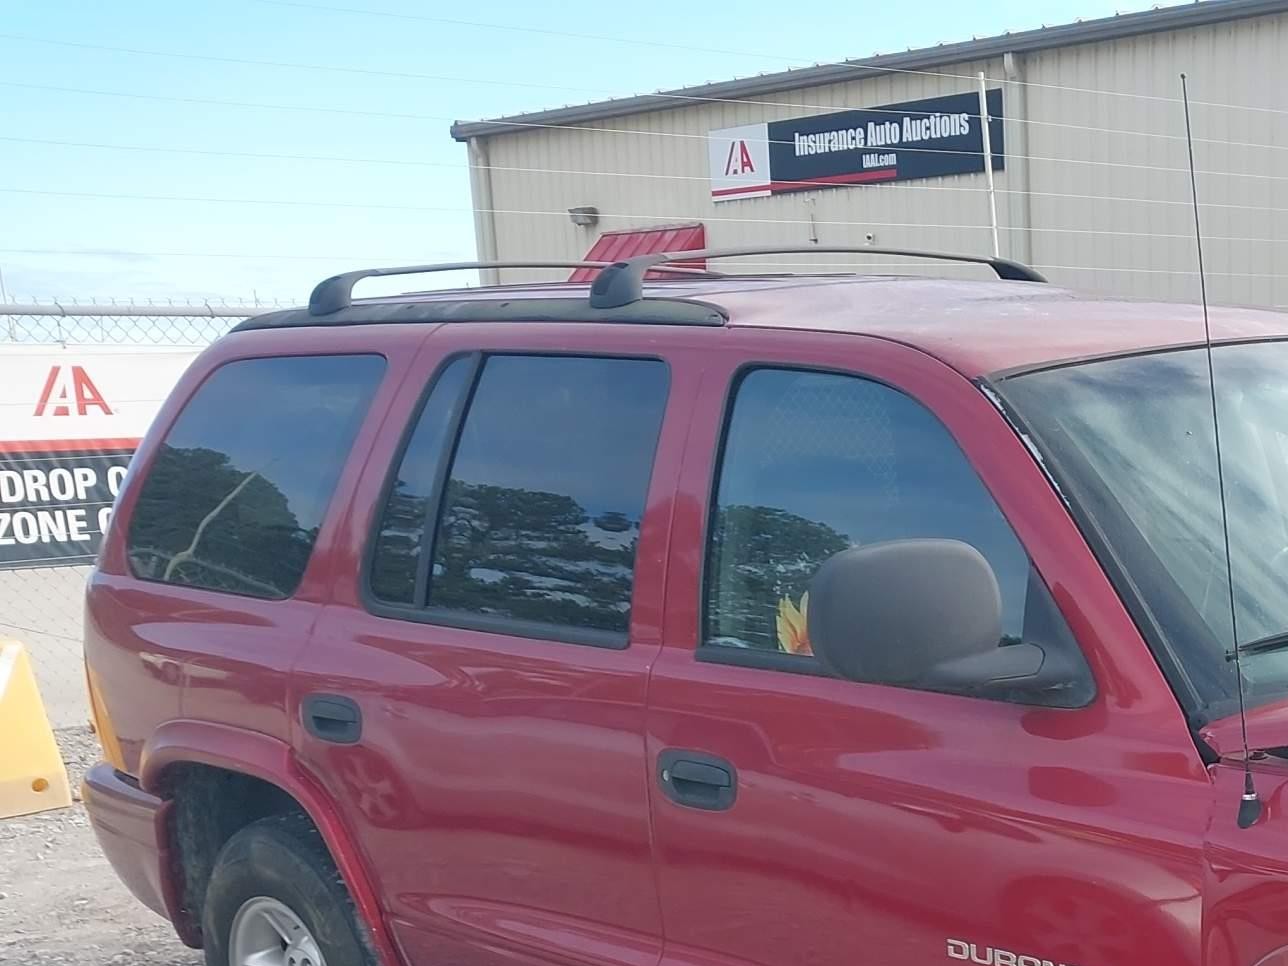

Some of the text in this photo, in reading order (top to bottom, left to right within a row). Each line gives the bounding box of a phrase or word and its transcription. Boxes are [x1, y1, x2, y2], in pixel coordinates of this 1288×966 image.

[794, 113, 970, 157] Insurance Auto Auctions
[0, 467, 97, 503] DROP
